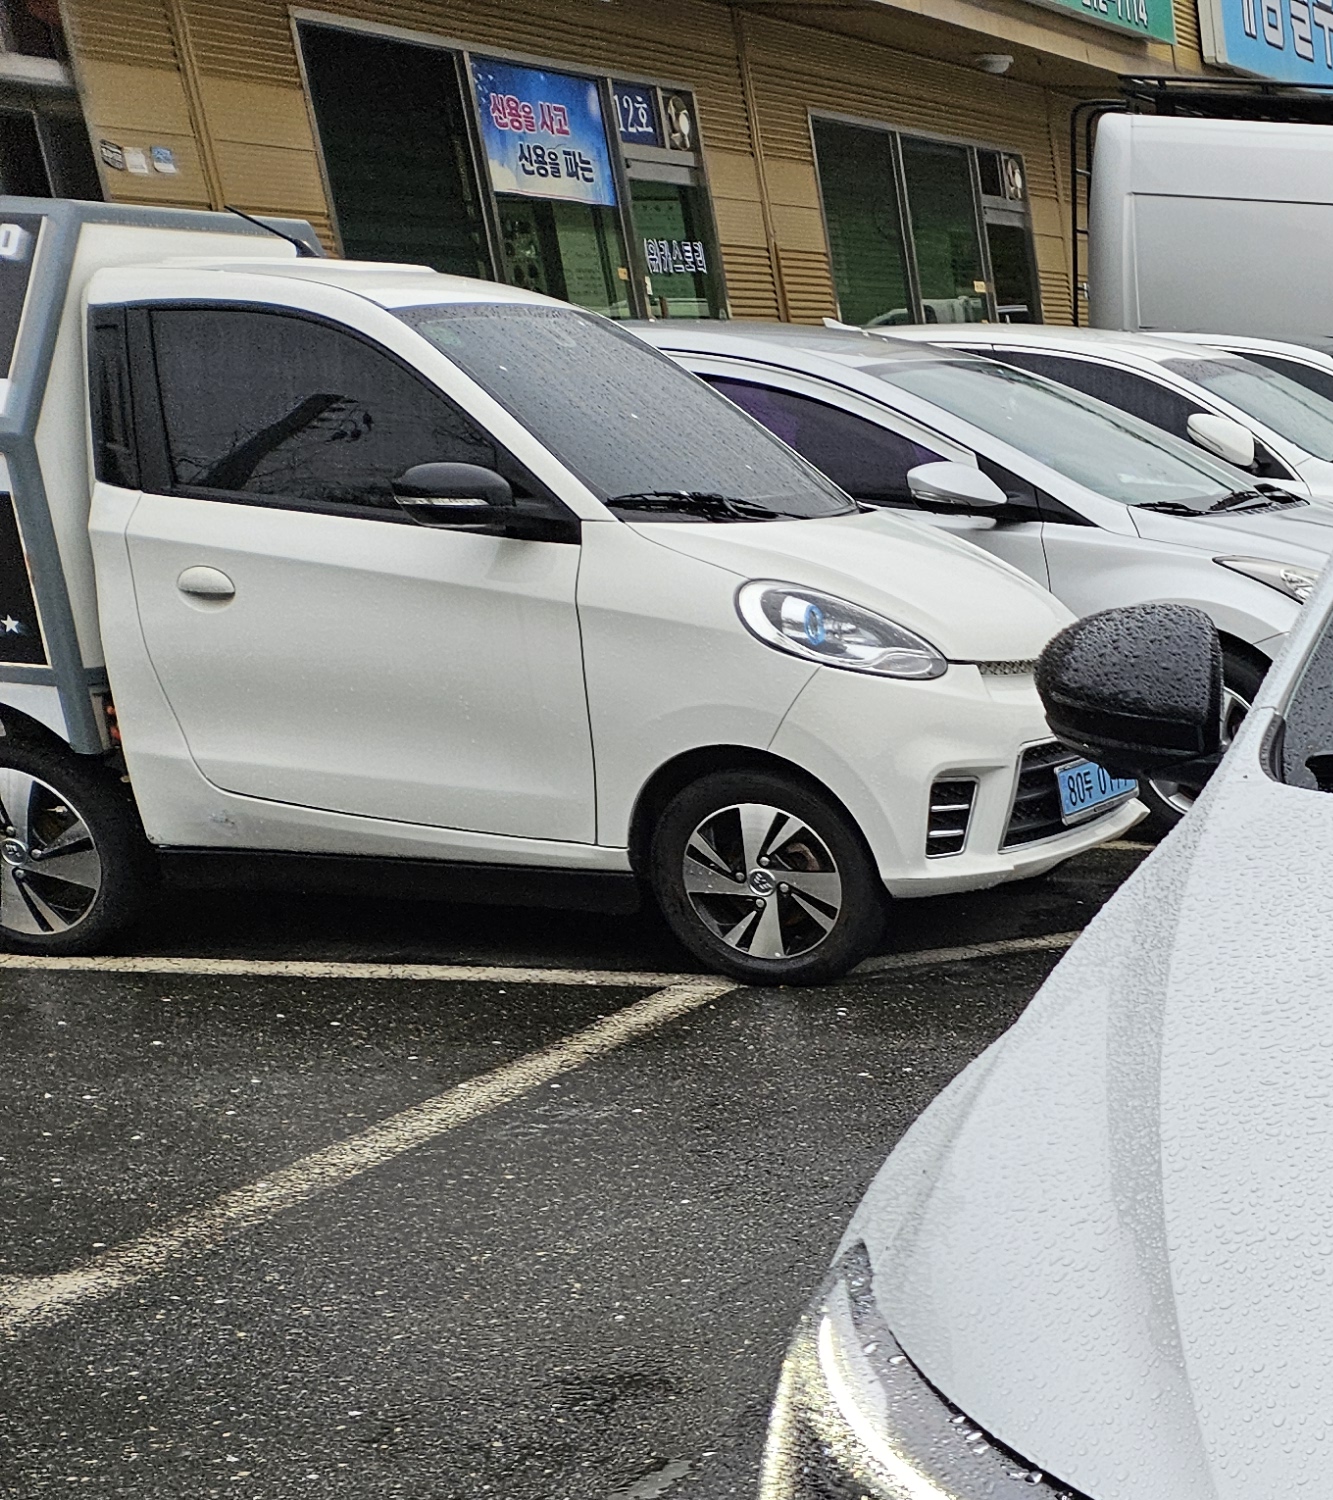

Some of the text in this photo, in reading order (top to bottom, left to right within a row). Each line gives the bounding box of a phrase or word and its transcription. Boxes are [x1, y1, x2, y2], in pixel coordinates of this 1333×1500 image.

[490, 92, 571, 137] 신용을 사고
[613, 94, 654, 134] 12호
[518, 141, 595, 183] 신용을 파는
